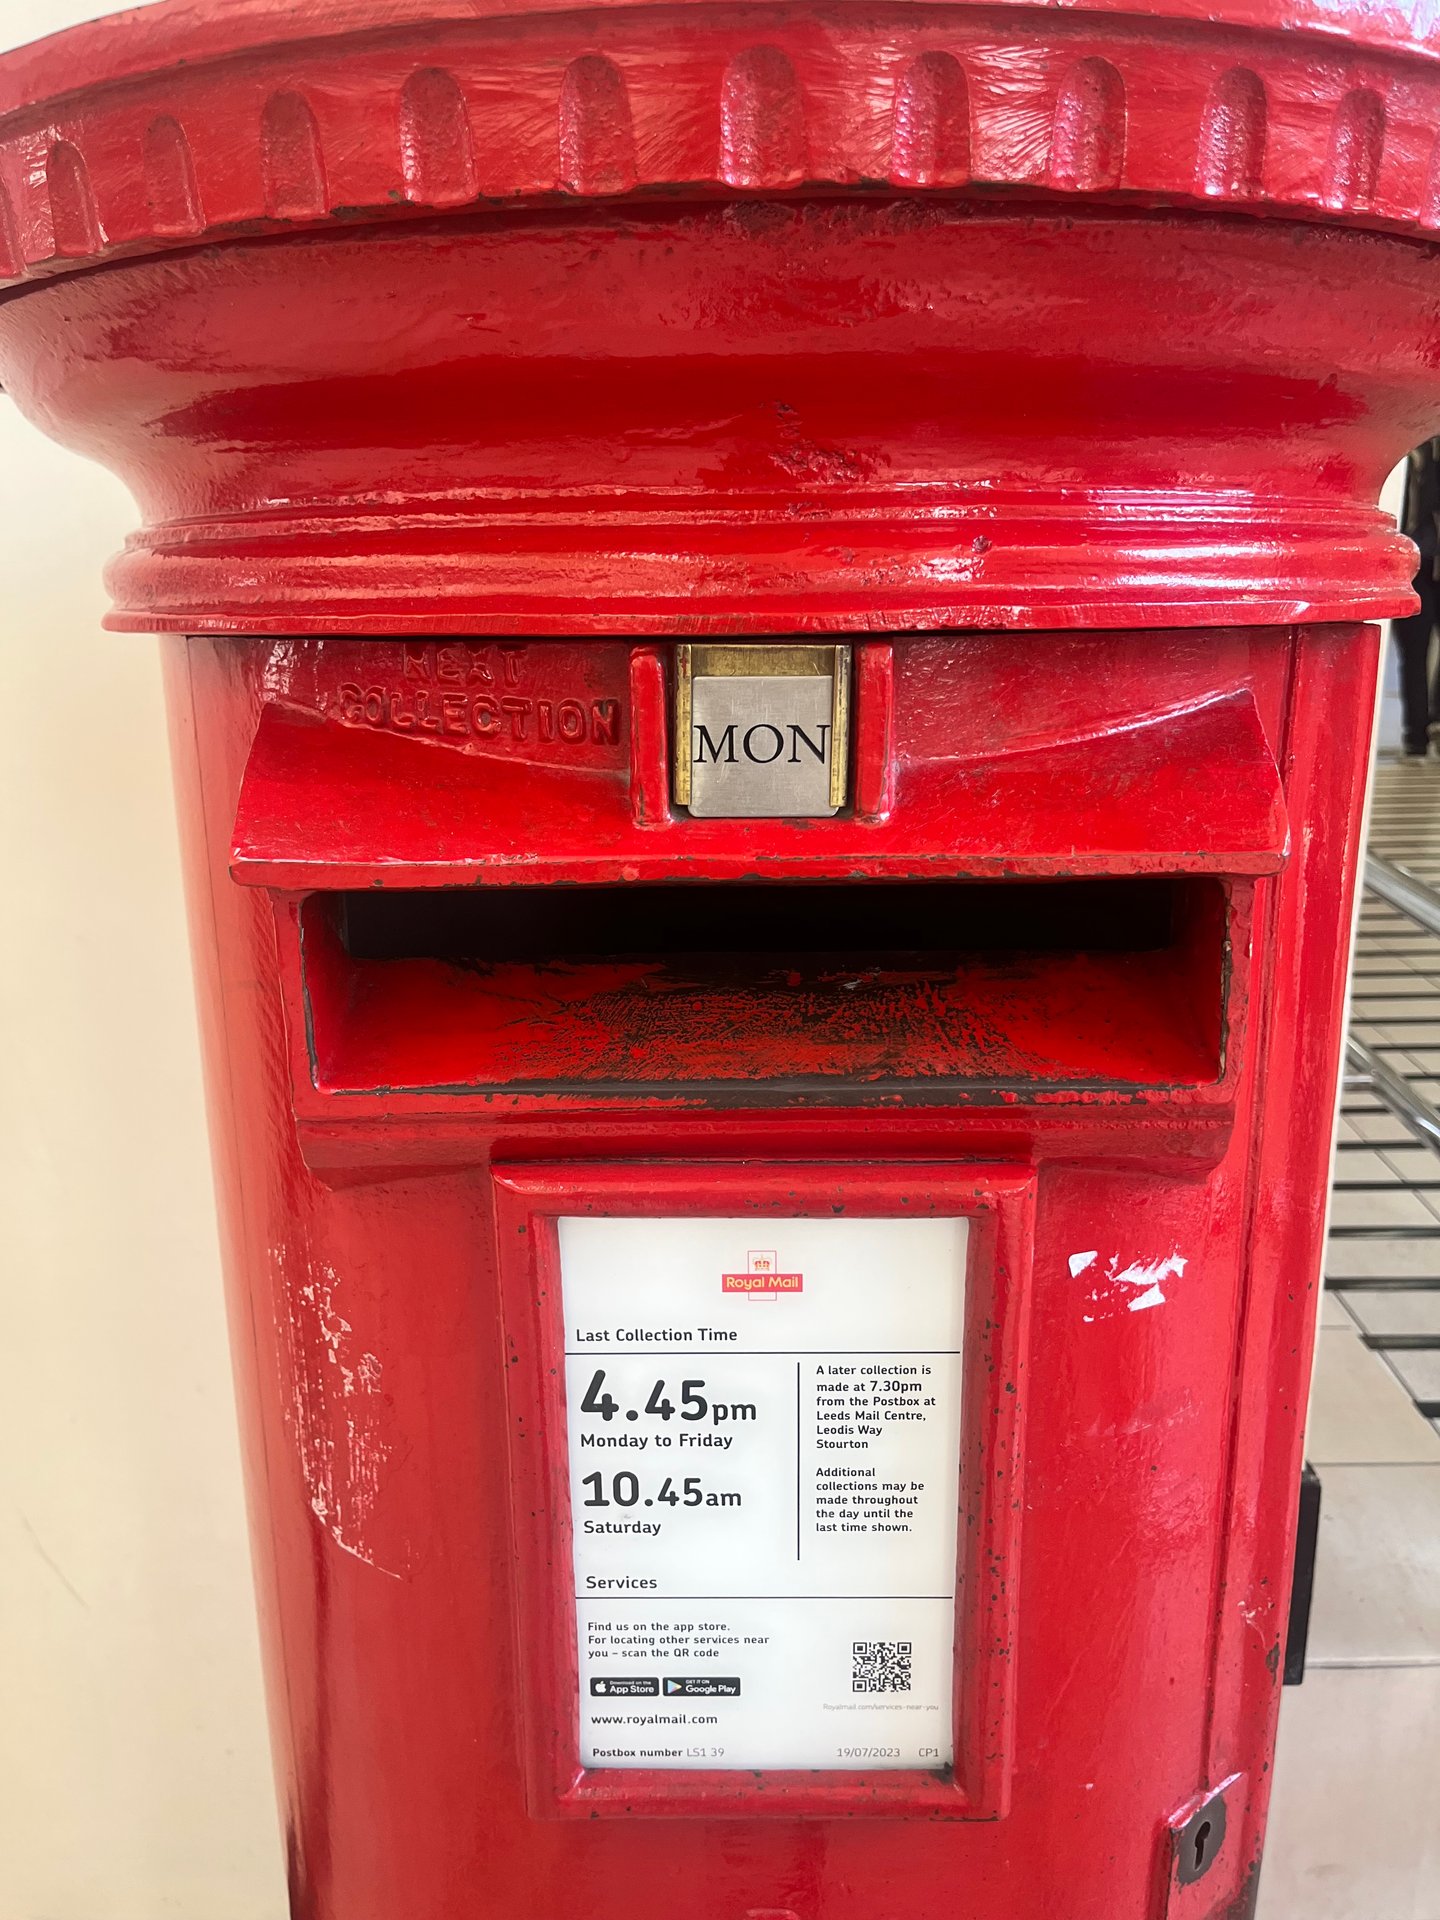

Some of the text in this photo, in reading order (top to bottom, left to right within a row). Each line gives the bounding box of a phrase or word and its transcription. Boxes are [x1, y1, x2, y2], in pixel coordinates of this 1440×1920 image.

[402, 643, 528, 686] NEXT
[338, 682, 621, 747] COLLECTION
[693, 724, 831, 765] MON
[726, 1276, 799, 1291] Royal Mail
[576, 1327, 738, 1342] Last Collection Time
[815, 1364, 932, 1375] A later collection is
[816, 1380, 922, 1395] made at 7.30pm
[580, 1369, 757, 1426] 4.45pm
[816, 1396, 936, 1407] from the Postbox at
[816, 1410, 926, 1422] Leeds Mail Centre,
[816, 1424, 883, 1437] Leodis Way
[580, 1432, 733, 1451] Monday to Friday
[816, 1438, 869, 1449] Stourton
[815, 1467, 876, 1477] Additional
[581, 1470, 742, 1507] 10.45am
[816, 1480, 925, 1493] collections may be
[815, 1495, 919, 1507] made throughout
[815, 1508, 914, 1521] the day until the
[583, 1520, 662, 1537] Saturday
[816, 1522, 912, 1532] last time shown.
[585, 1575, 658, 1590] Services
[587, 1621, 612, 1632] Find
[616, 1623, 630, 1631] us
[650, 1621, 670, 1631] the
[673, 1623, 694, 1633] app
[698, 1622, 730, 1631] store.
[588, 1634, 607, 1645] For
[610, 1634, 655, 1646] locating
[659, 1635, 690, 1644] other
[693, 1634, 740, 1644] services
[588, 1650, 609, 1660] you
[621, 1650, 647, 1658] scan
[651, 1648, 670, 1658] the
[673, 1648, 690, 1658] QR
[693, 1648, 720, 1657] code
[609, 1685, 655, 1695] App Store
[685, 1684, 737, 1695] Google Play
[823, 1703, 940, 1712] Royalmail.com/services-near-you
[590, 1713, 718, 1727] www.royalmail.com
[592, 1747, 725, 1758] Postbox number LS1 39
[837, 1747, 901, 1758] 19/07/2023
[918, 1747, 939, 1758] CP1
